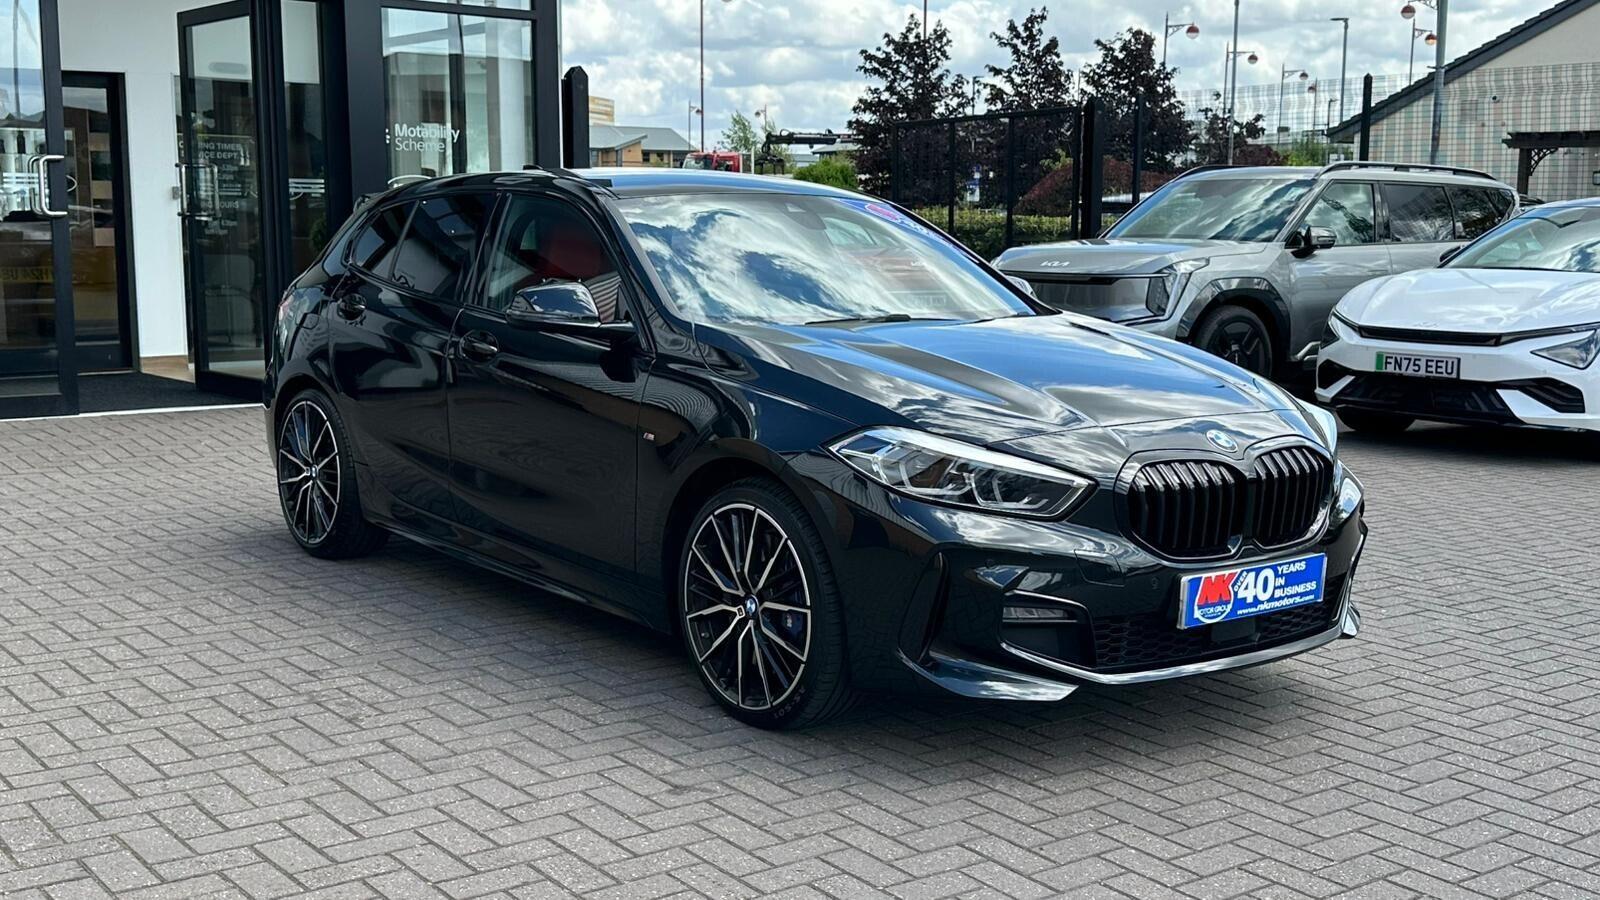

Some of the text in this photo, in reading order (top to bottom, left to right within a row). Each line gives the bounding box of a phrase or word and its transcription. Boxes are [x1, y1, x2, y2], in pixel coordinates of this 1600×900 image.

[395, 137, 445, 153] Scheme
[1384, 355, 1455, 375] FN75 EEU
[1197, 571, 1239, 606] NK
[1233, 561, 1306, 603] OVER 40 YEARS
[1274, 581, 1317, 598] BUSINESS
[1275, 576, 1285, 586] IN
[1237, 594, 1315, 616] www.nkmotors.com
